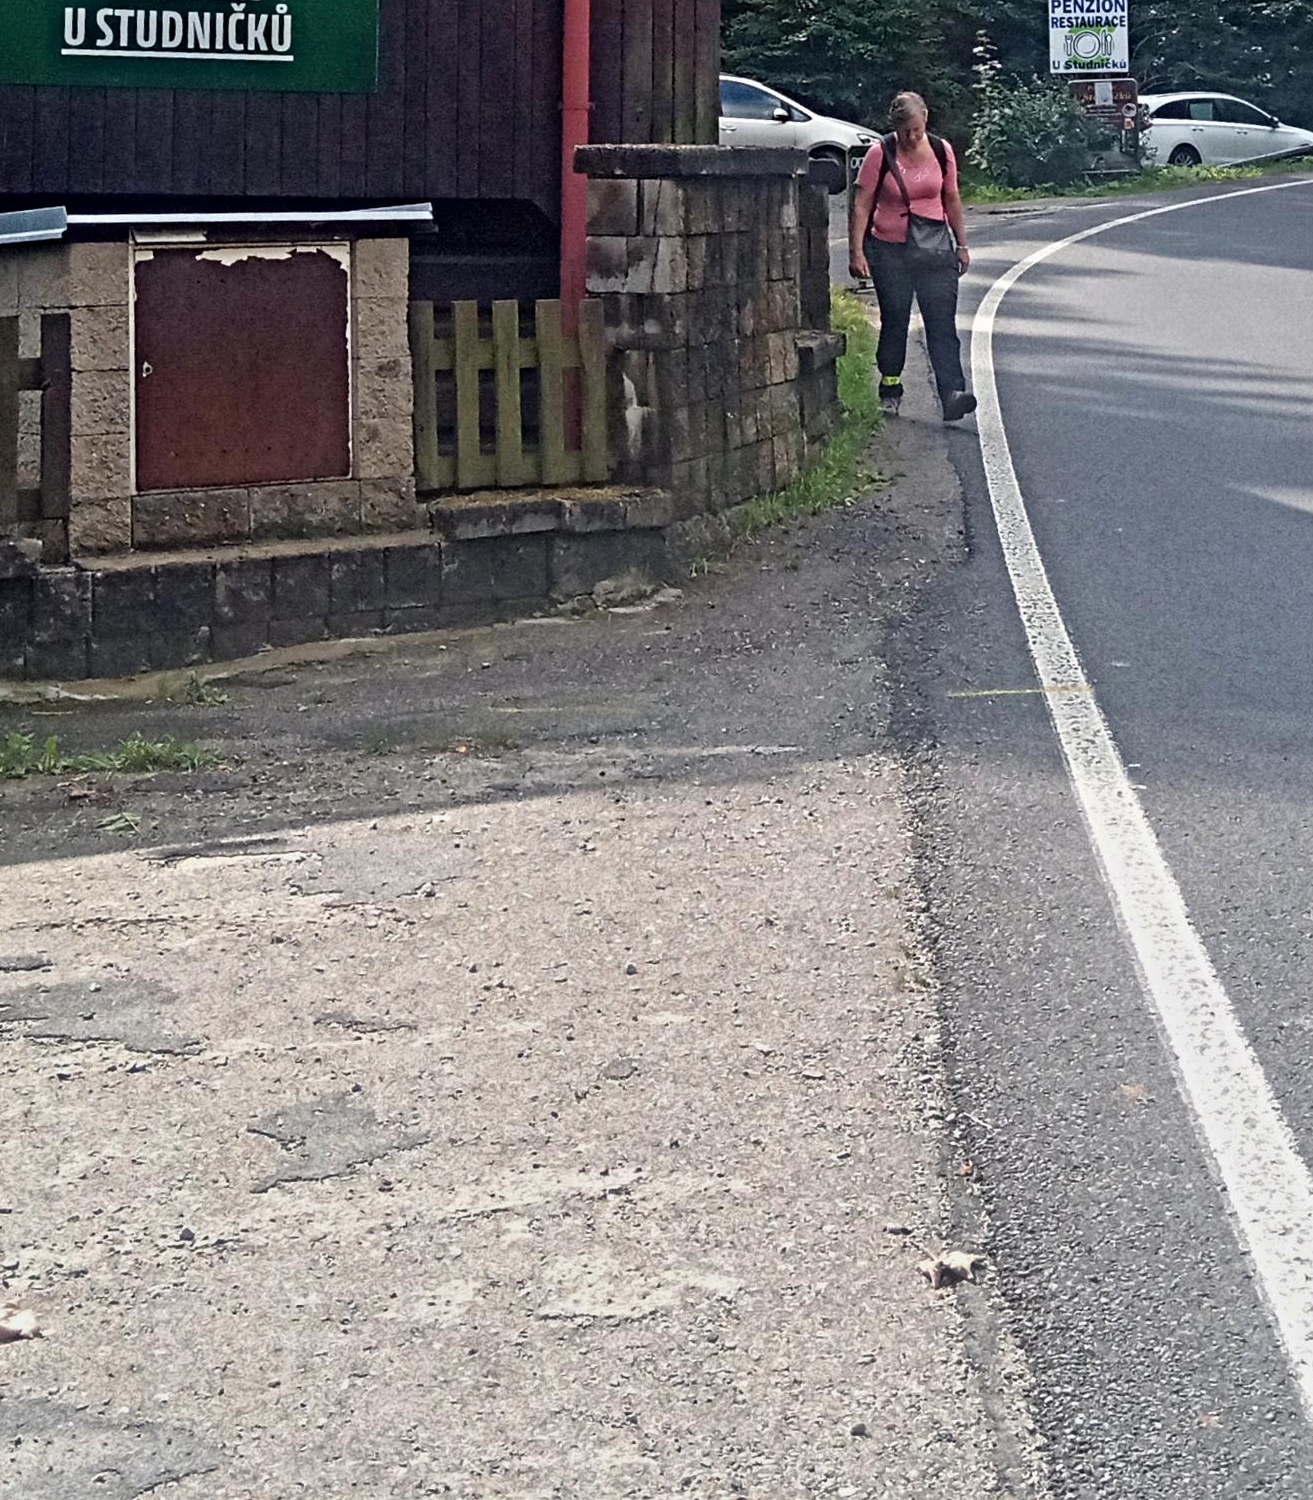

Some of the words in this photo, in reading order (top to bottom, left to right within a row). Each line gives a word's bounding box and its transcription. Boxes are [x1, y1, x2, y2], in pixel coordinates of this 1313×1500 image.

[63, 7, 86, 46] U
[96, 3, 293, 52] STUDNIČKŮ
[1051, 16, 1126, 28] RESTAURACE
[1052, 60, 1060, 69] U
